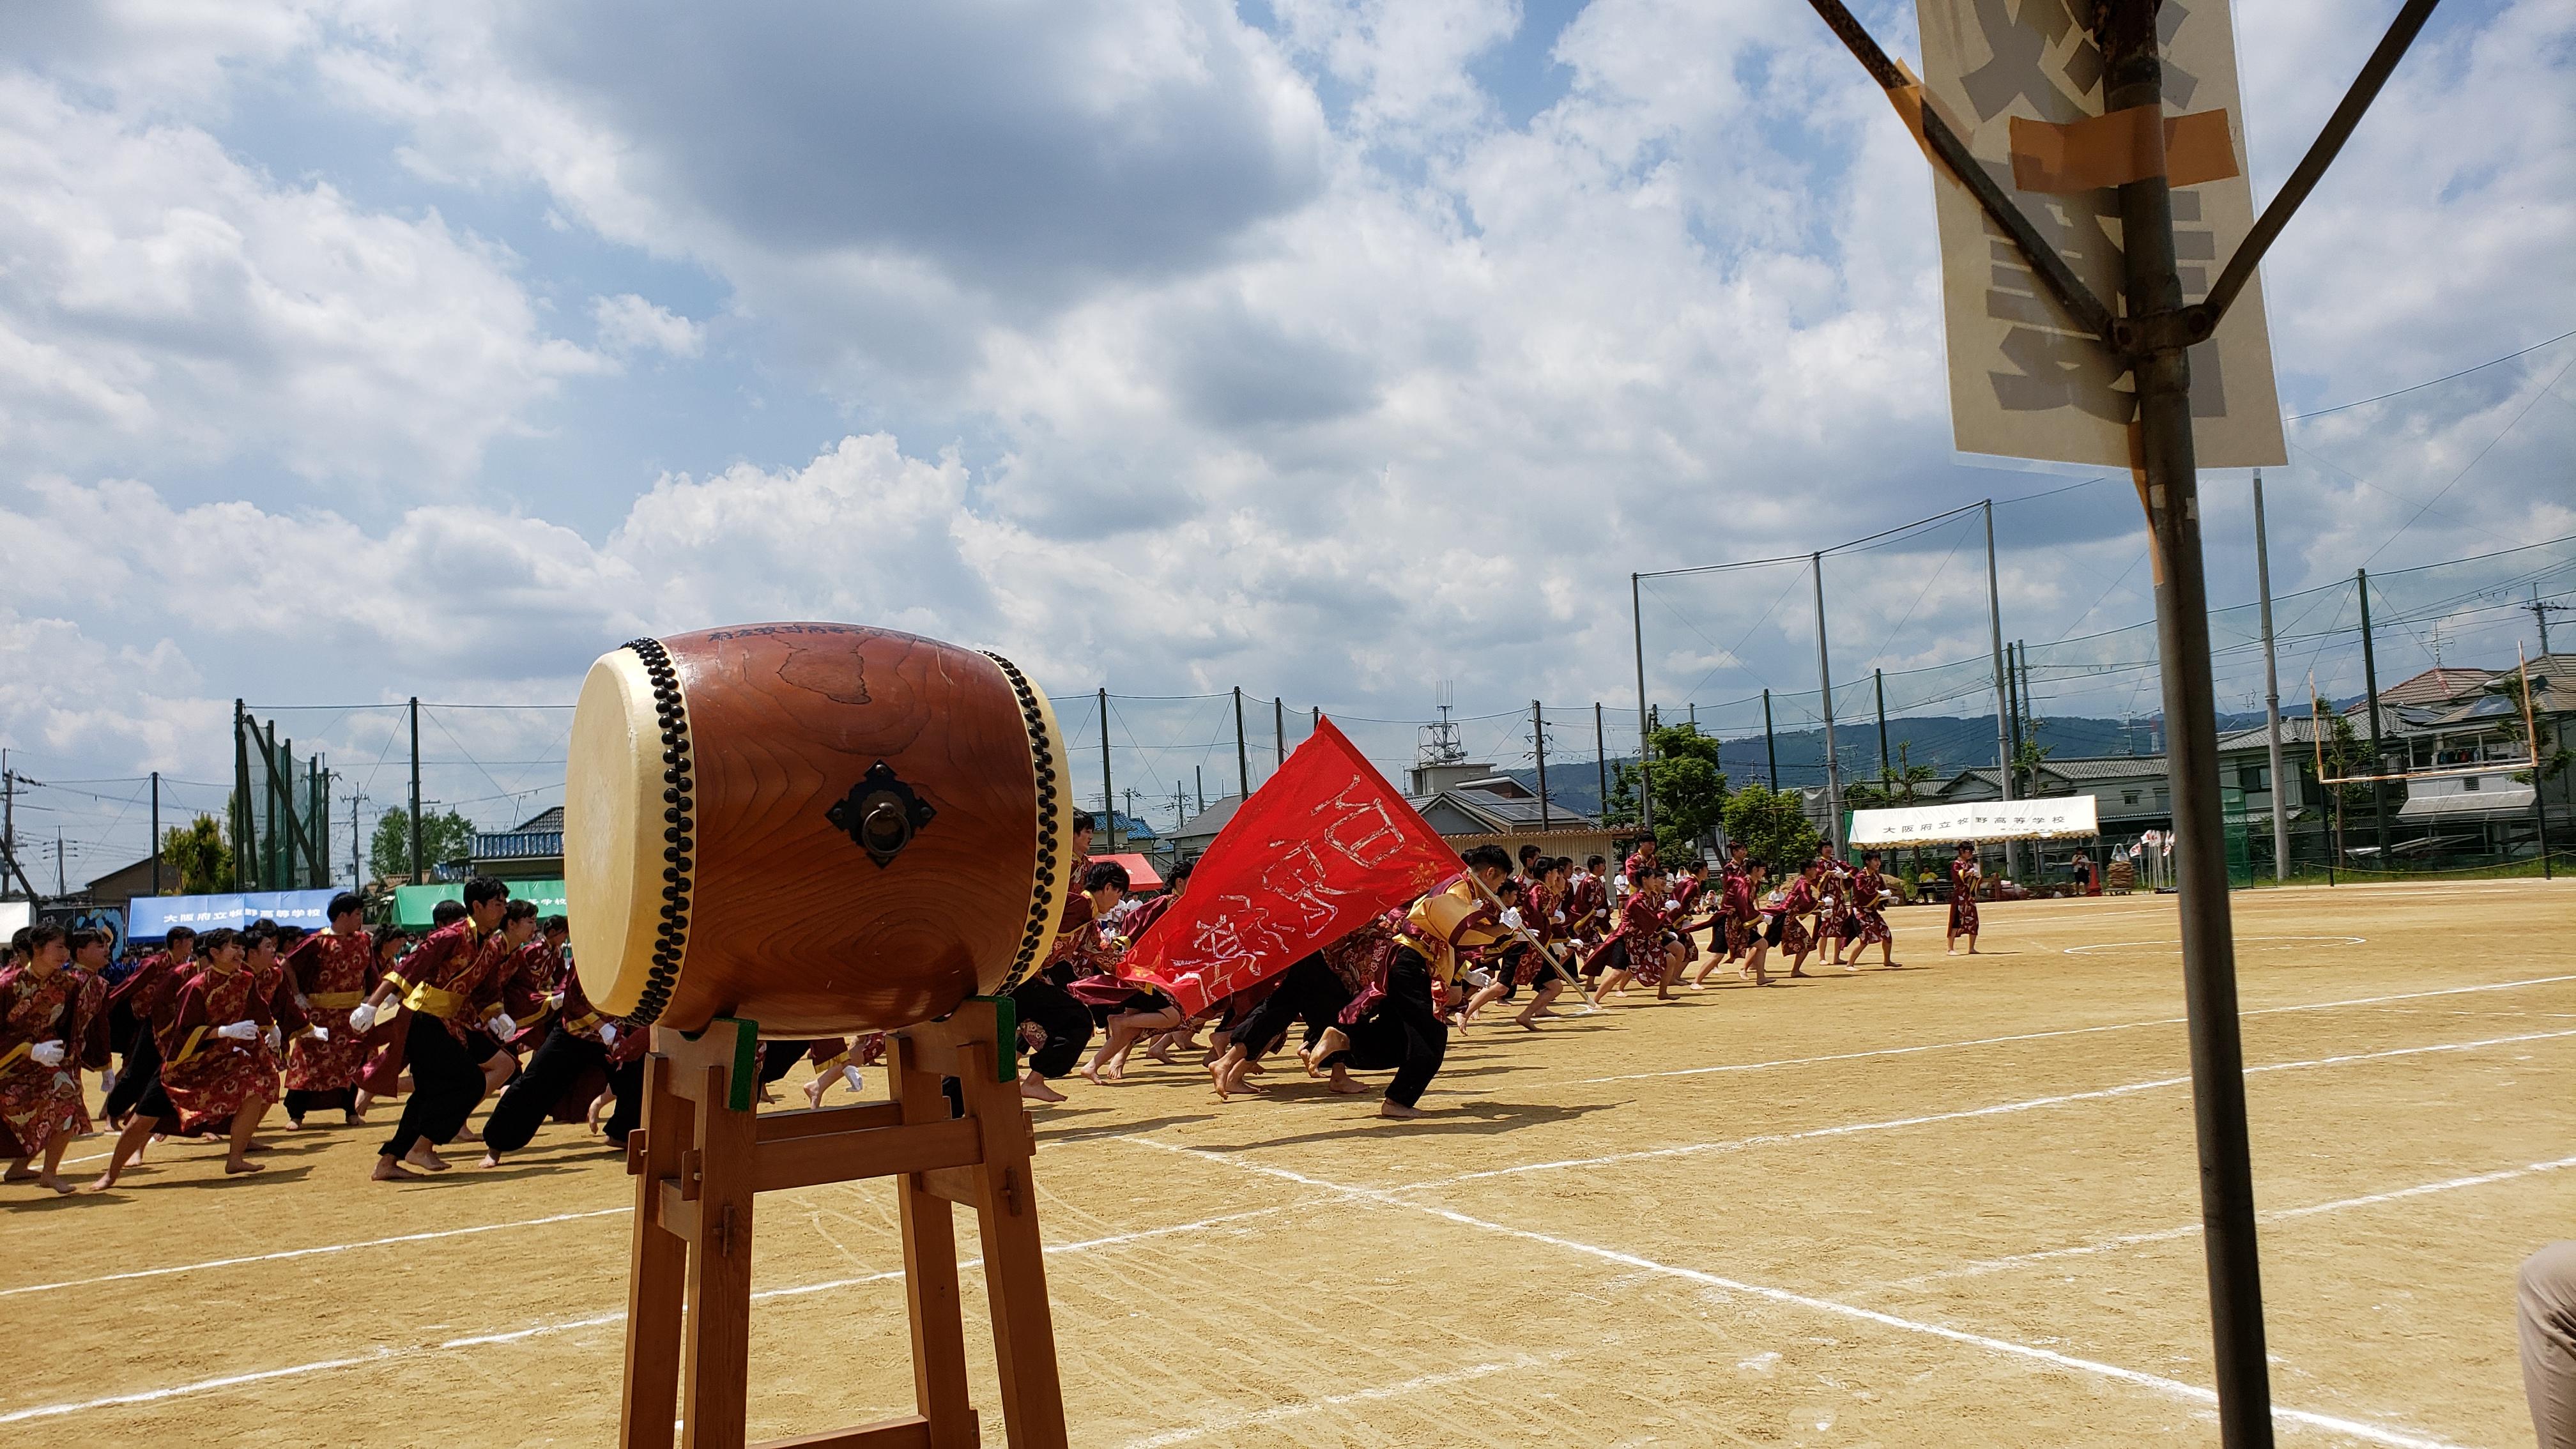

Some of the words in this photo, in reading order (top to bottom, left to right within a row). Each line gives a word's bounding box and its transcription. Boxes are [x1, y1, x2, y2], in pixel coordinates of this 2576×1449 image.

[1883, 816, 2066, 834] 大阪府立牧野高等学校
